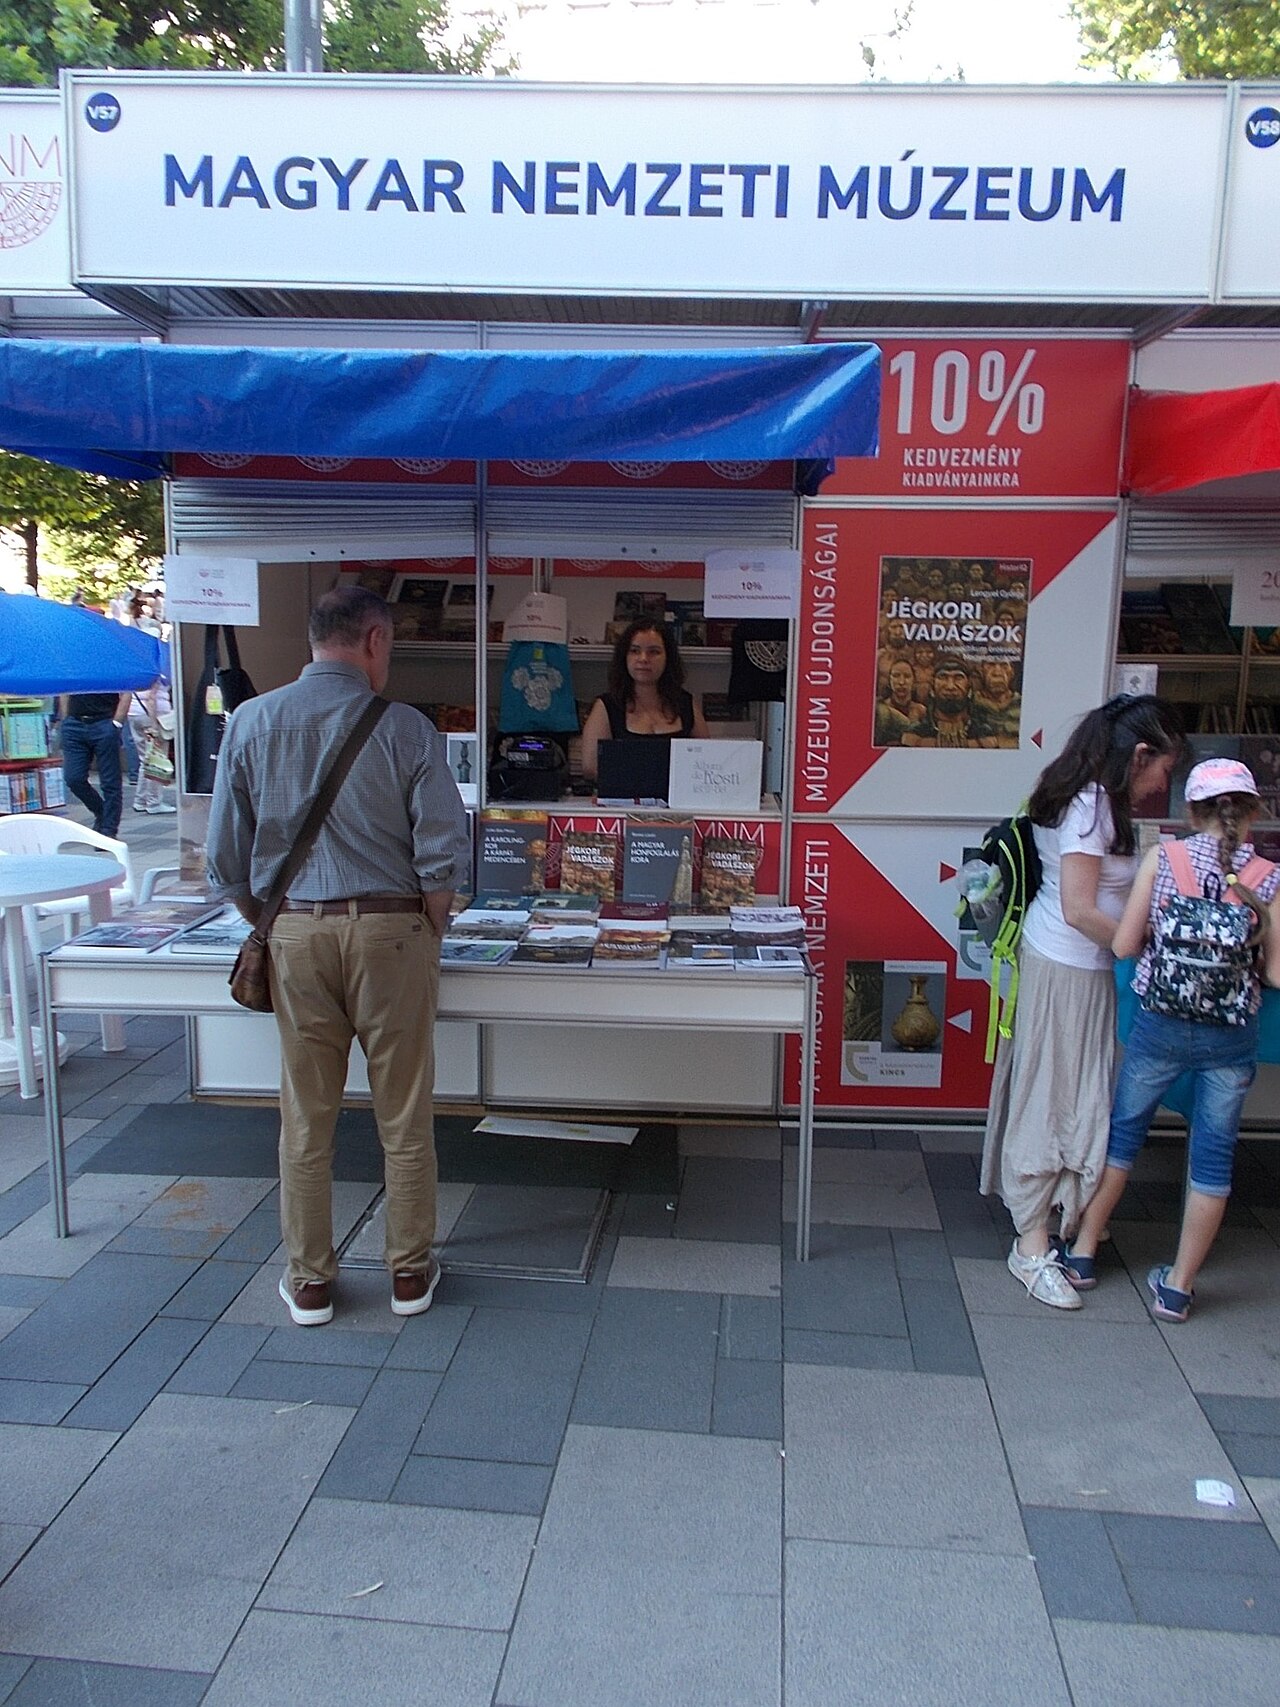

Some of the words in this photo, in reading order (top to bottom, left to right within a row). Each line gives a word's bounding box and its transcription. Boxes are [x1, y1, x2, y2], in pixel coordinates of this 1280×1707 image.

[86, 104, 120, 121] V57
[1248, 119, 1280, 136] V58
[163, 153, 466, 213] MAGYAR
[491, 160, 790, 218] NEMZETI
[816, 149, 1126, 222] MÚZEUM
[889, 348, 1045, 437] 10%
[903, 444, 1022, 467] KEDVEZMÉNY
[902, 469, 1020, 488] KIADVÁNYAINKRA
[805, 522, 839, 686] ÚJDONSÁGAI
[886, 596, 981, 620] JÉGKORI
[902, 620, 1022, 643] VADÁSZOK
[801, 697, 832, 803] MÚZEUM
